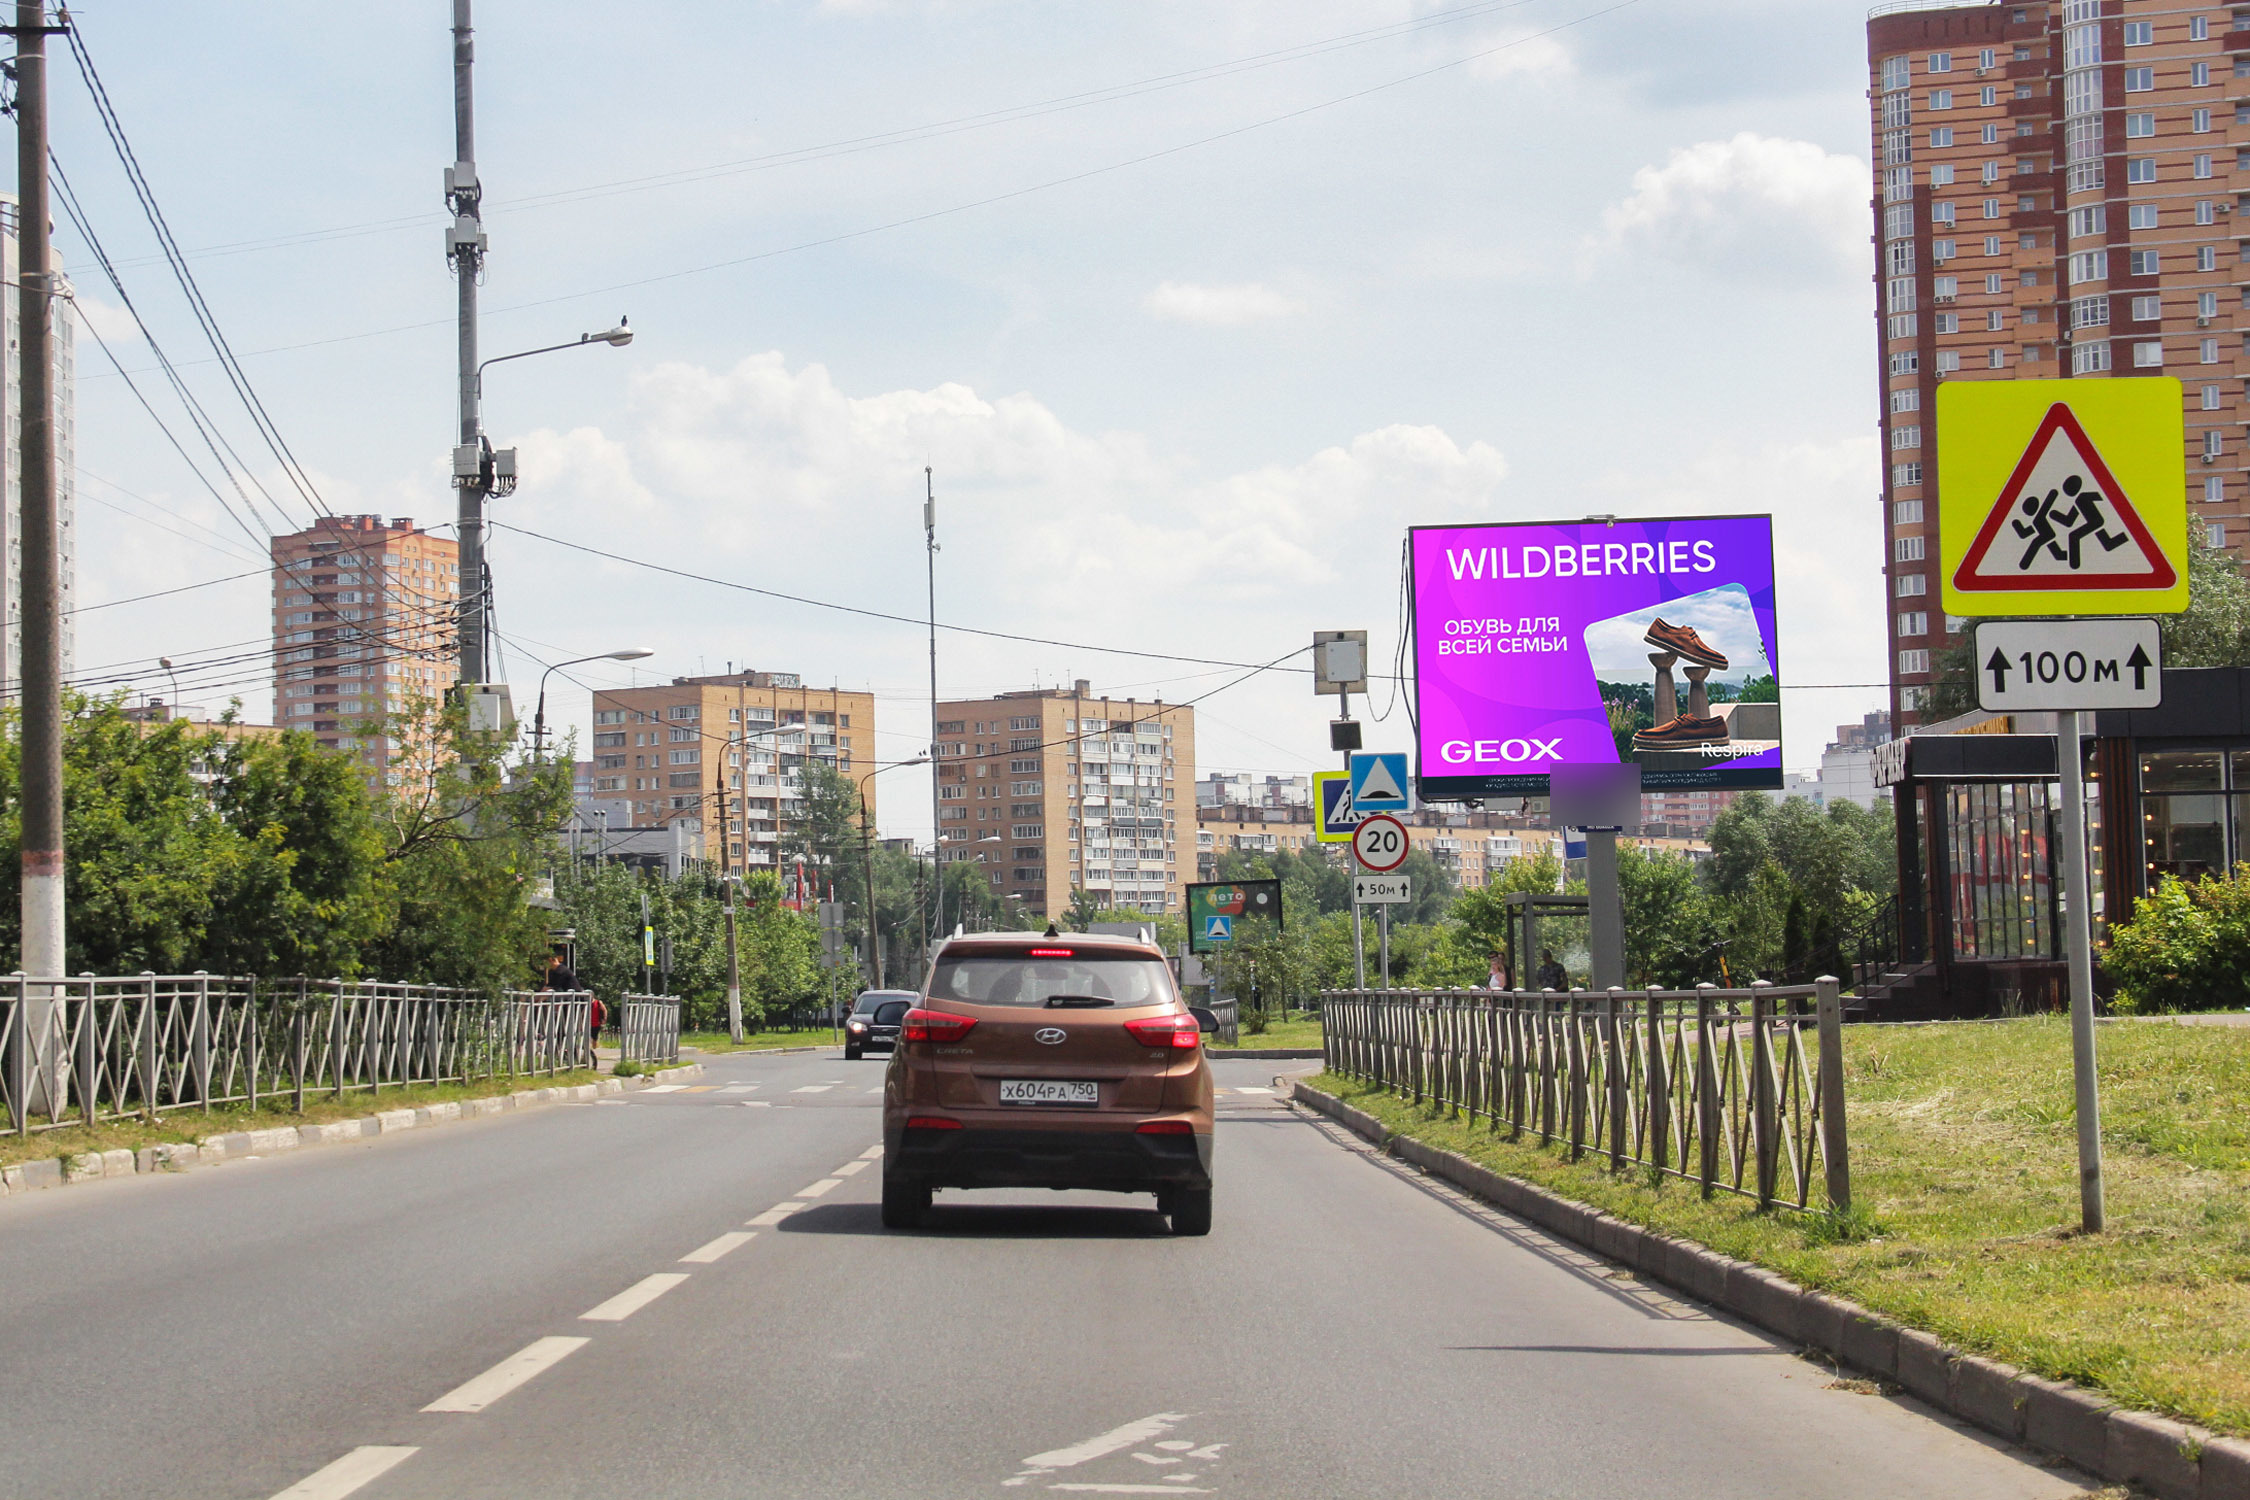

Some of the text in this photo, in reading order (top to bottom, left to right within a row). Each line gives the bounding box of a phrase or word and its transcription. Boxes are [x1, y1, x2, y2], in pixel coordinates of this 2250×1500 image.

[1446, 540, 1716, 580] WILDBERRIES
[1444, 617, 1560, 635] ОБУВЬ ДЛЯ
[1438, 635, 1568, 655] ВСЕЙ СЕМЬИ
[1440, 738, 1564, 763] GEOX
[1701, 741, 1764, 760] Respira
[1366, 830, 1398, 853] 20
